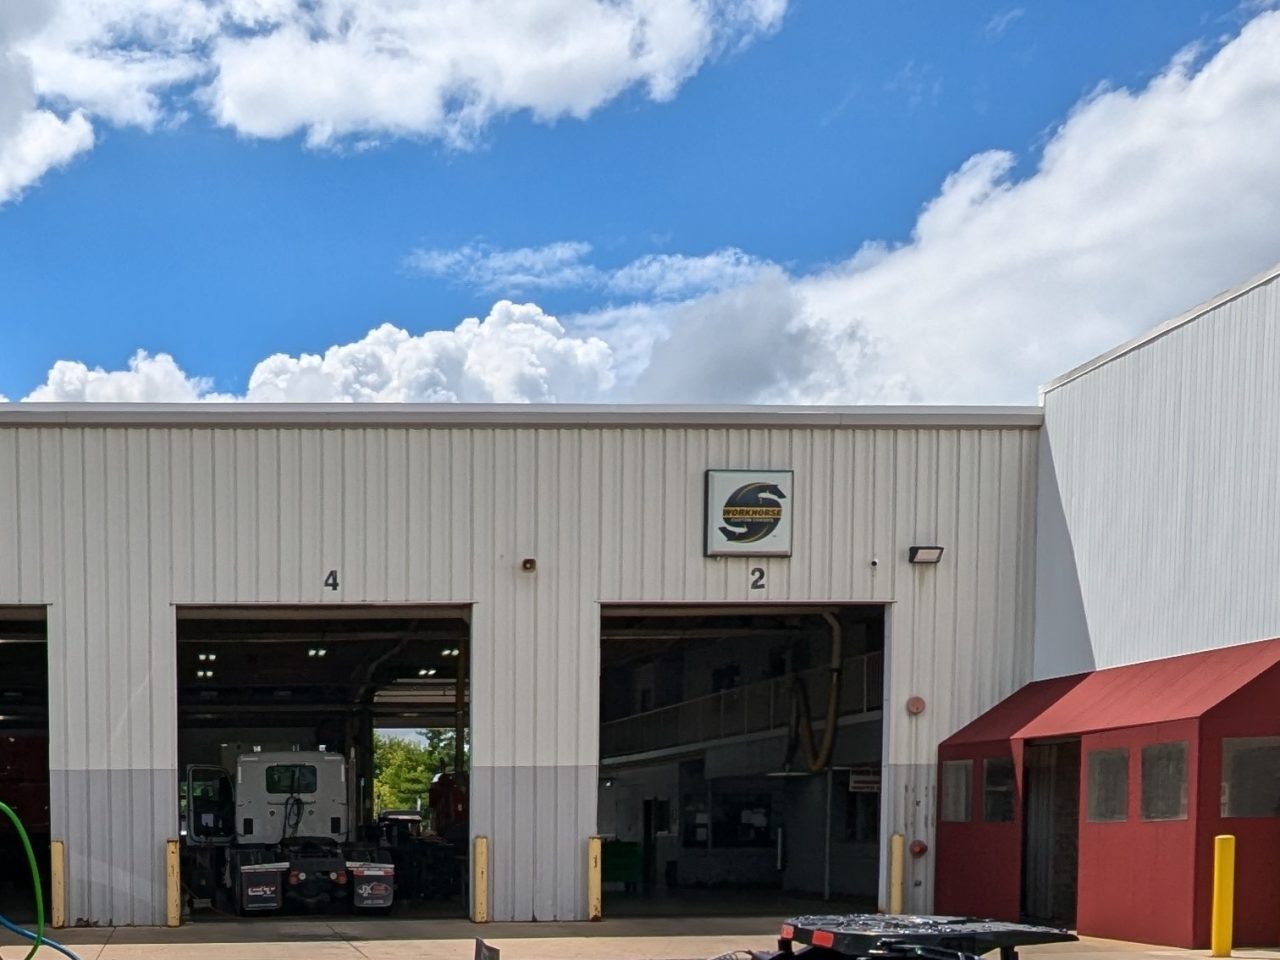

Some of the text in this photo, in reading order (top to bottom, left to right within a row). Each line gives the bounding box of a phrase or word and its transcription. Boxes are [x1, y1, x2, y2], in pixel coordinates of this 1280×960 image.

[723, 508, 782, 517] WORKHORSE
[323, 569, 339, 591] 4
[750, 567, 766, 590] 2
